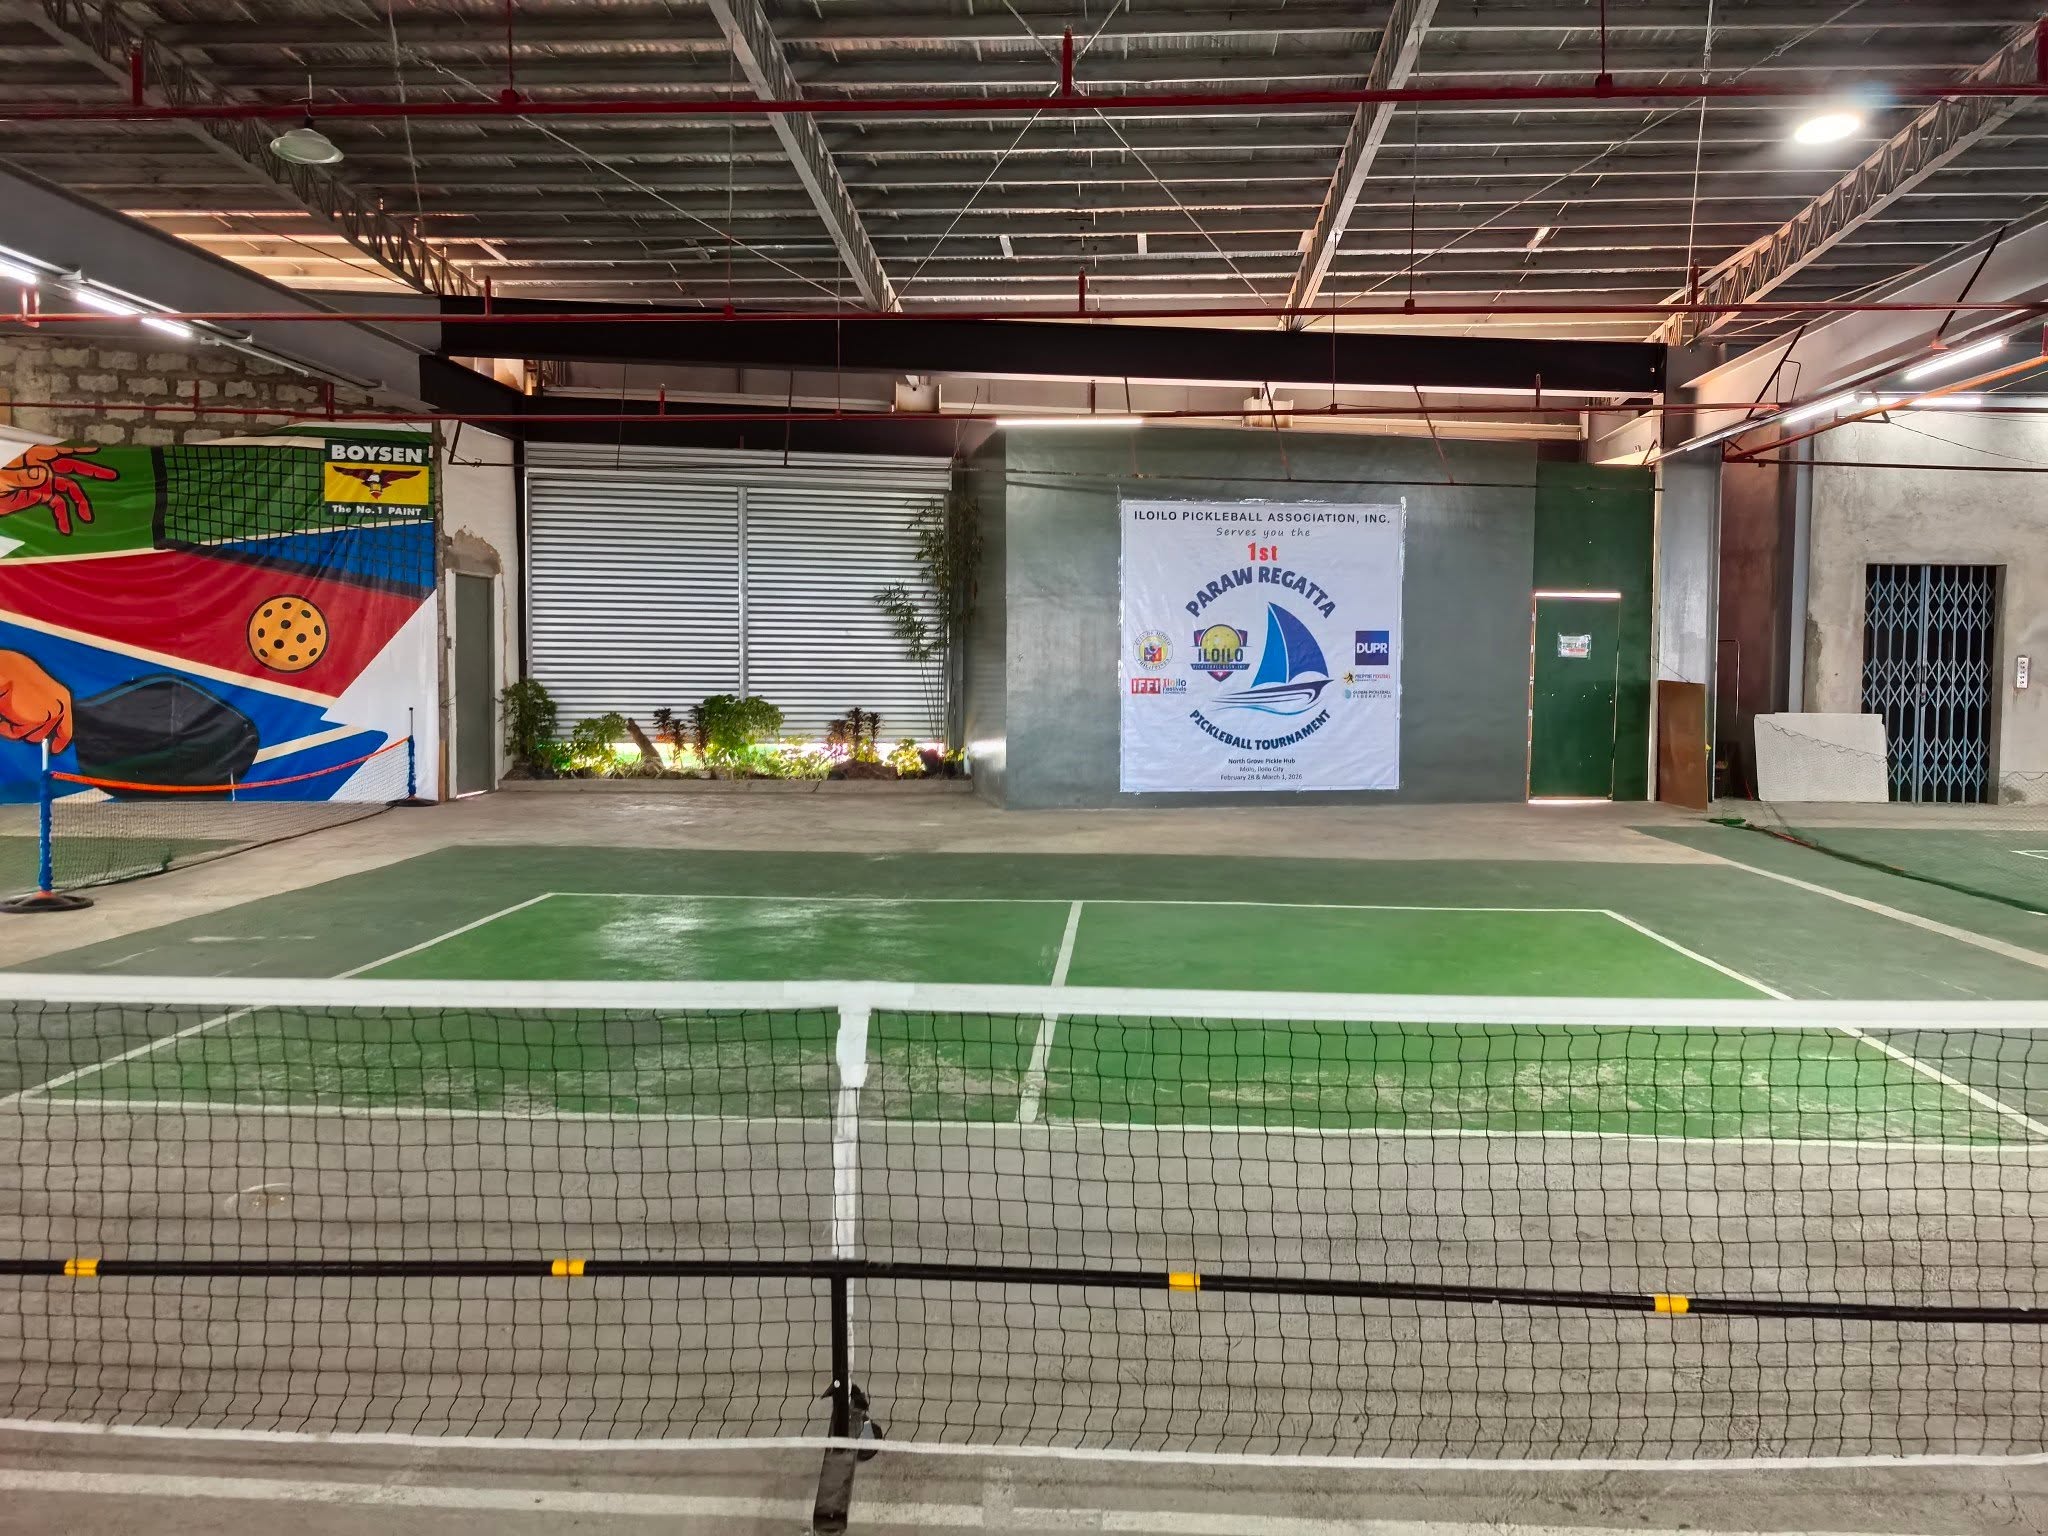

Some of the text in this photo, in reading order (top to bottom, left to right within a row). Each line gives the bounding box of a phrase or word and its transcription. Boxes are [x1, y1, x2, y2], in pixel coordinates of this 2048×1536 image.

[331, 444, 423, 464] BOYSEN
[332, 505, 352, 514] The
[388, 506, 422, 516] PAINT
[1134, 510, 1391, 524] ILOILO PICKLEBALL ASSOCIATION, INC.
[1216, 526, 1311, 539] Serves you the
[1247, 542, 1278, 561] 1st
[1185, 565, 1336, 619] PARAW REGATTA
[1197, 647, 1244, 662] ILOILO
[1356, 642, 1388, 654] DUPR
[1132, 678, 1159, 694] IFFI
[1189, 709, 1331, 751] PICKLEBALL TOURNAMENT
